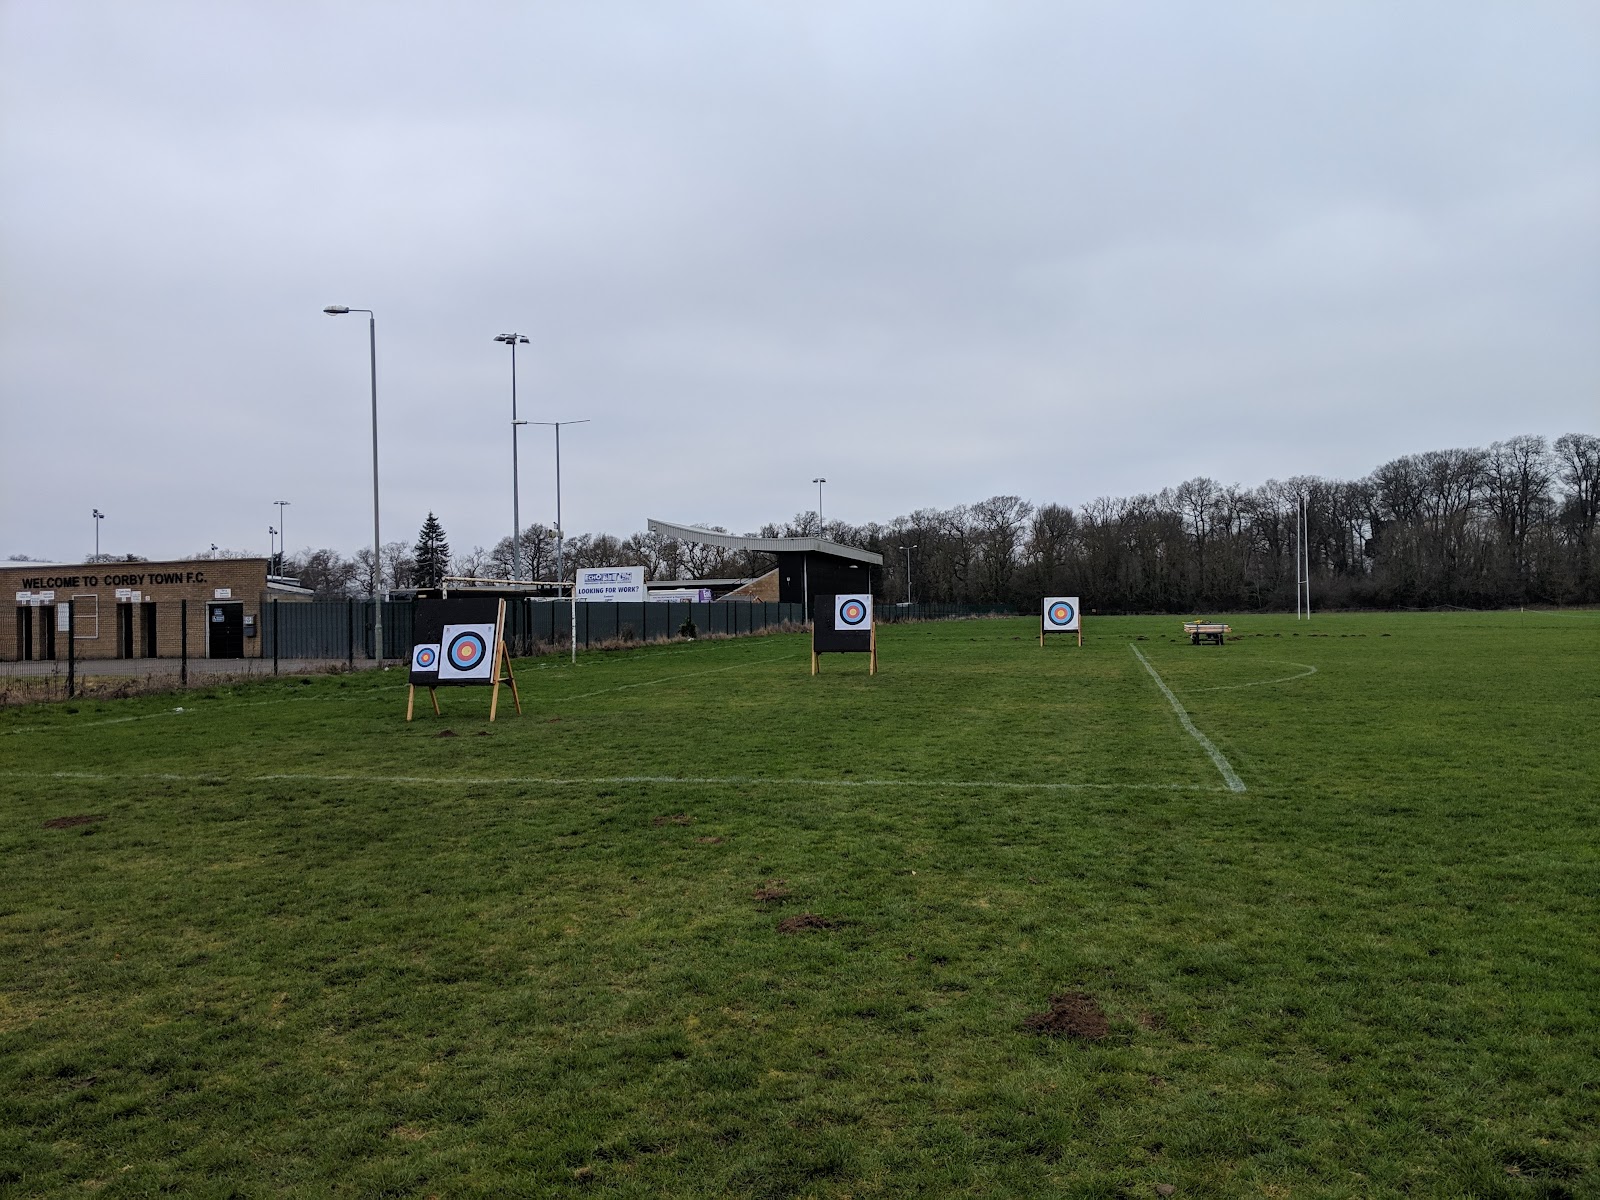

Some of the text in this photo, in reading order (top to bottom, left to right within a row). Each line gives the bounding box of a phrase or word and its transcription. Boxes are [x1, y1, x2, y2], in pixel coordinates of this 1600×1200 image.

[22, 571, 207, 589] WELCOME TO CORBY TOWN F.C.
[578, 587, 604, 595] LOOKING
[617, 585, 640, 593] WORK?
